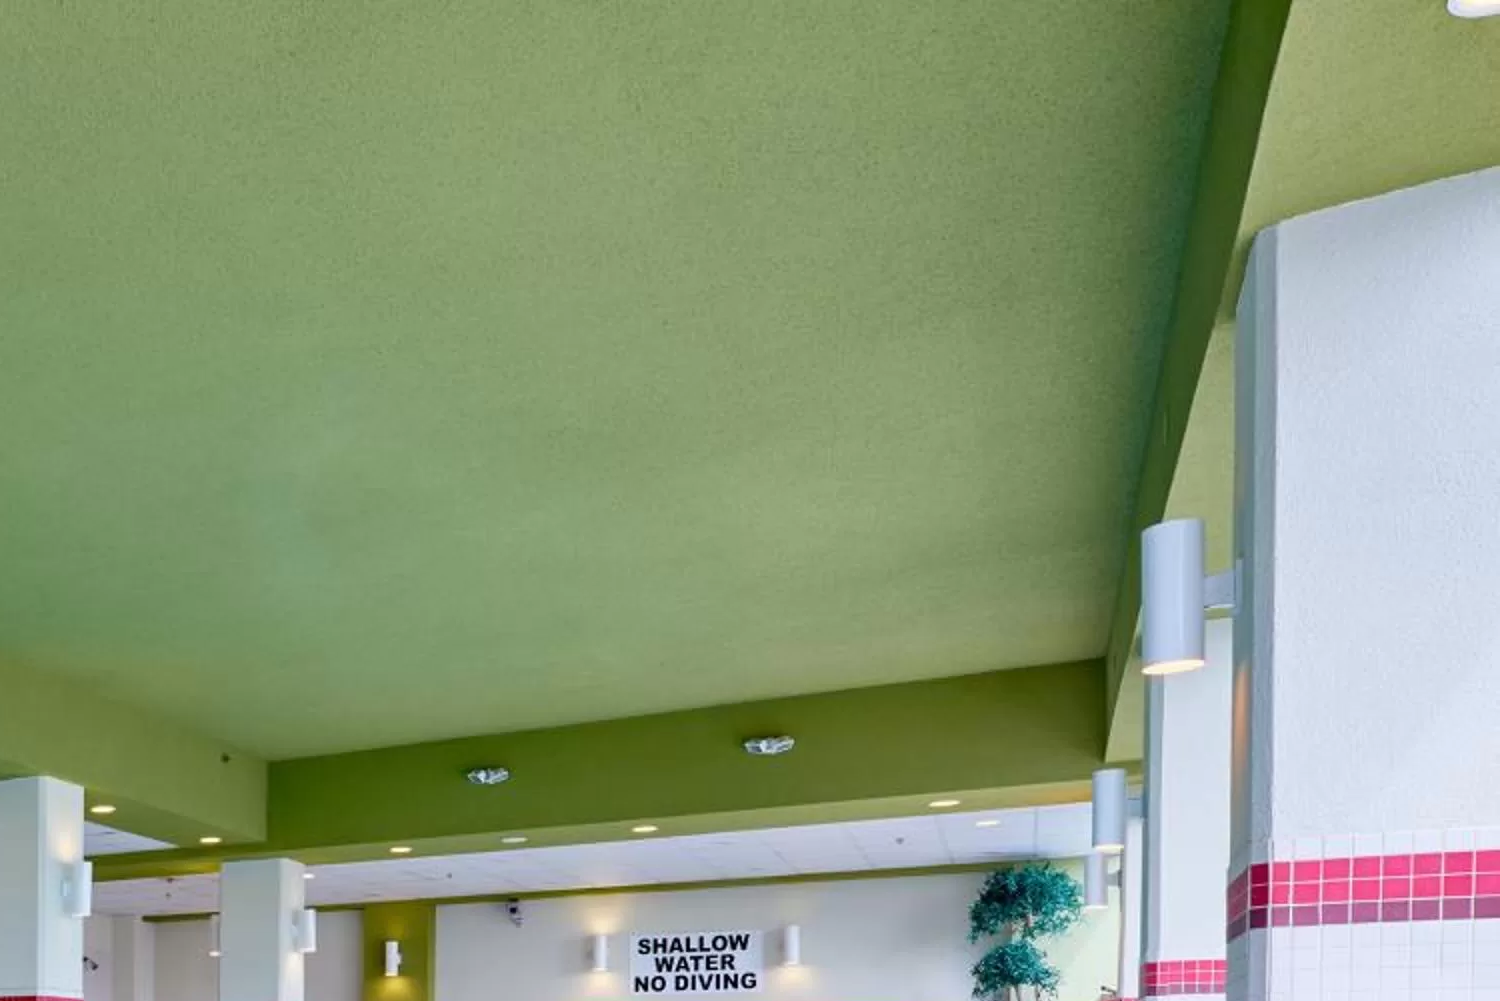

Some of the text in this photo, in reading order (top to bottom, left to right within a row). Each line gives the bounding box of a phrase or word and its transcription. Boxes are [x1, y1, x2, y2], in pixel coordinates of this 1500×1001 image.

[637, 933, 750, 955] SHALLOW
[655, 954, 735, 973] WATER
[634, 972, 757, 992] NO DIVING
